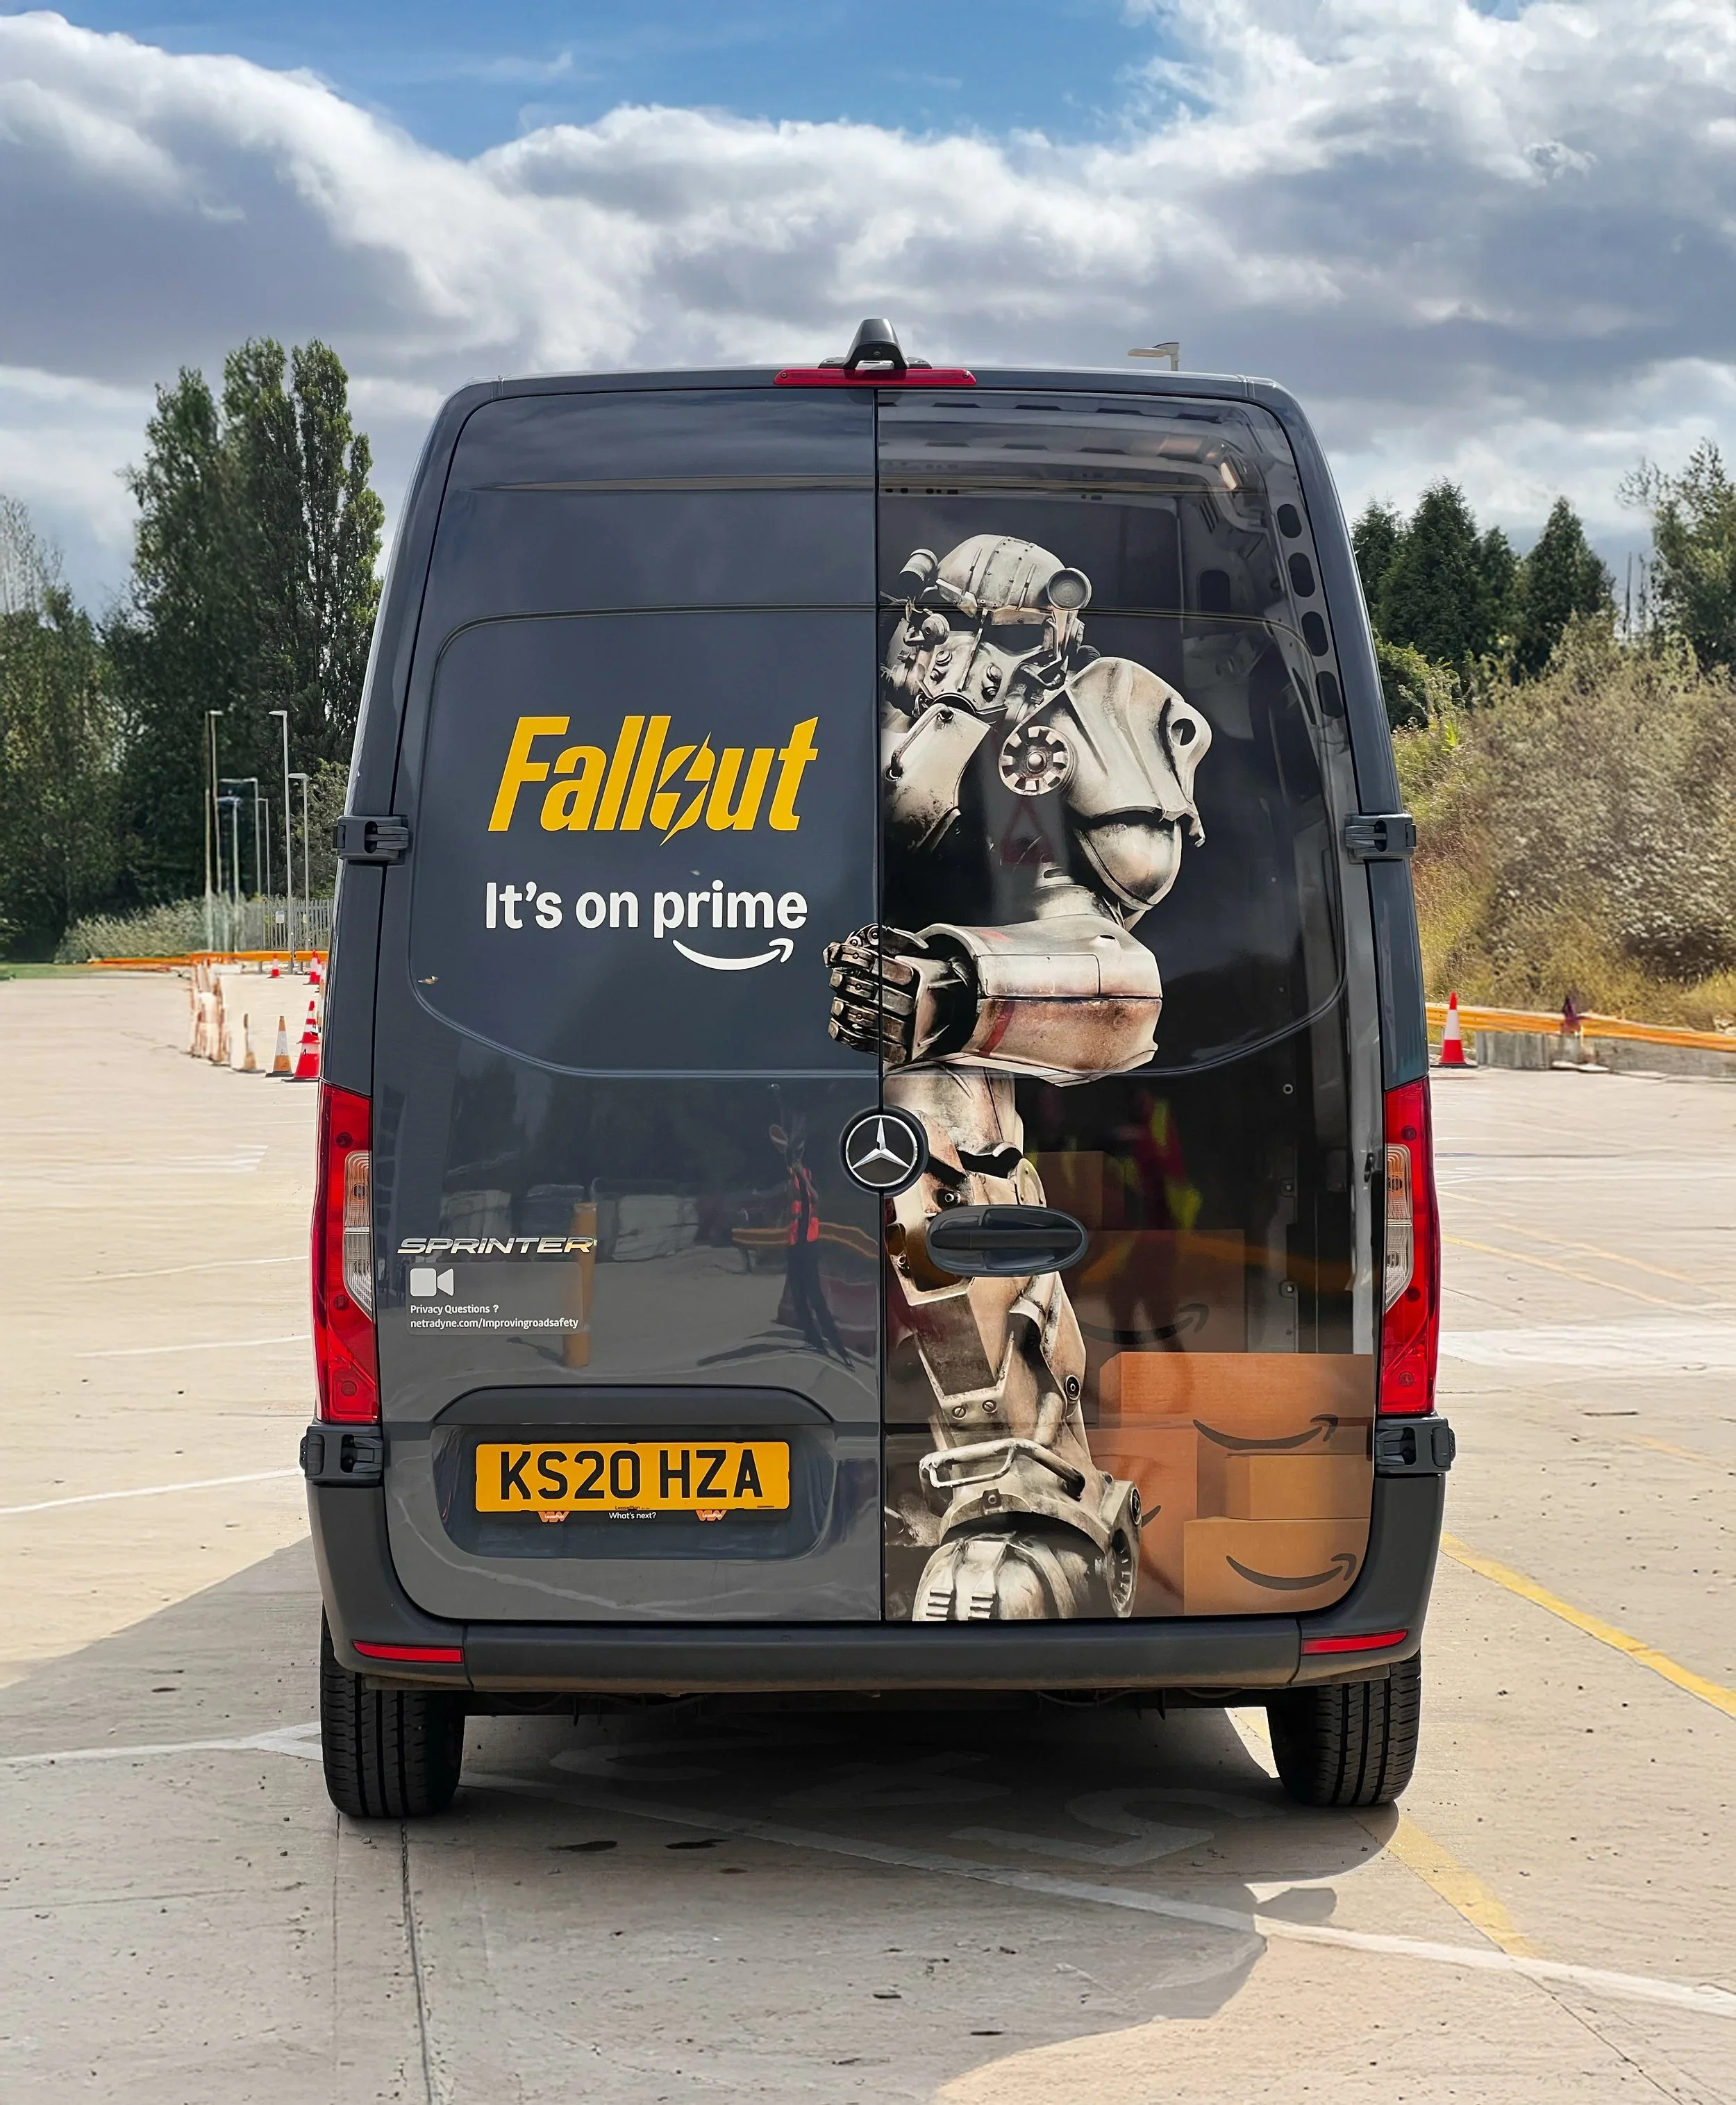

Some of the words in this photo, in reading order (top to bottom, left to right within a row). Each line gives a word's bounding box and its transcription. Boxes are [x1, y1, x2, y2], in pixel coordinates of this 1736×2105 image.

[487, 715, 819, 847] Fallout
[485, 881, 563, 930] It's
[575, 891, 640, 930] on
[653, 879, 808, 939] prime
[397, 1238, 594, 1254] SPRINTER
[410, 1305, 443, 1315] Privacy
[444, 1305, 490, 1314] Questions
[493, 1304, 499, 1313] ?
[500, 1449, 641, 1500] KS20
[659, 1449, 763, 1499] HZA
